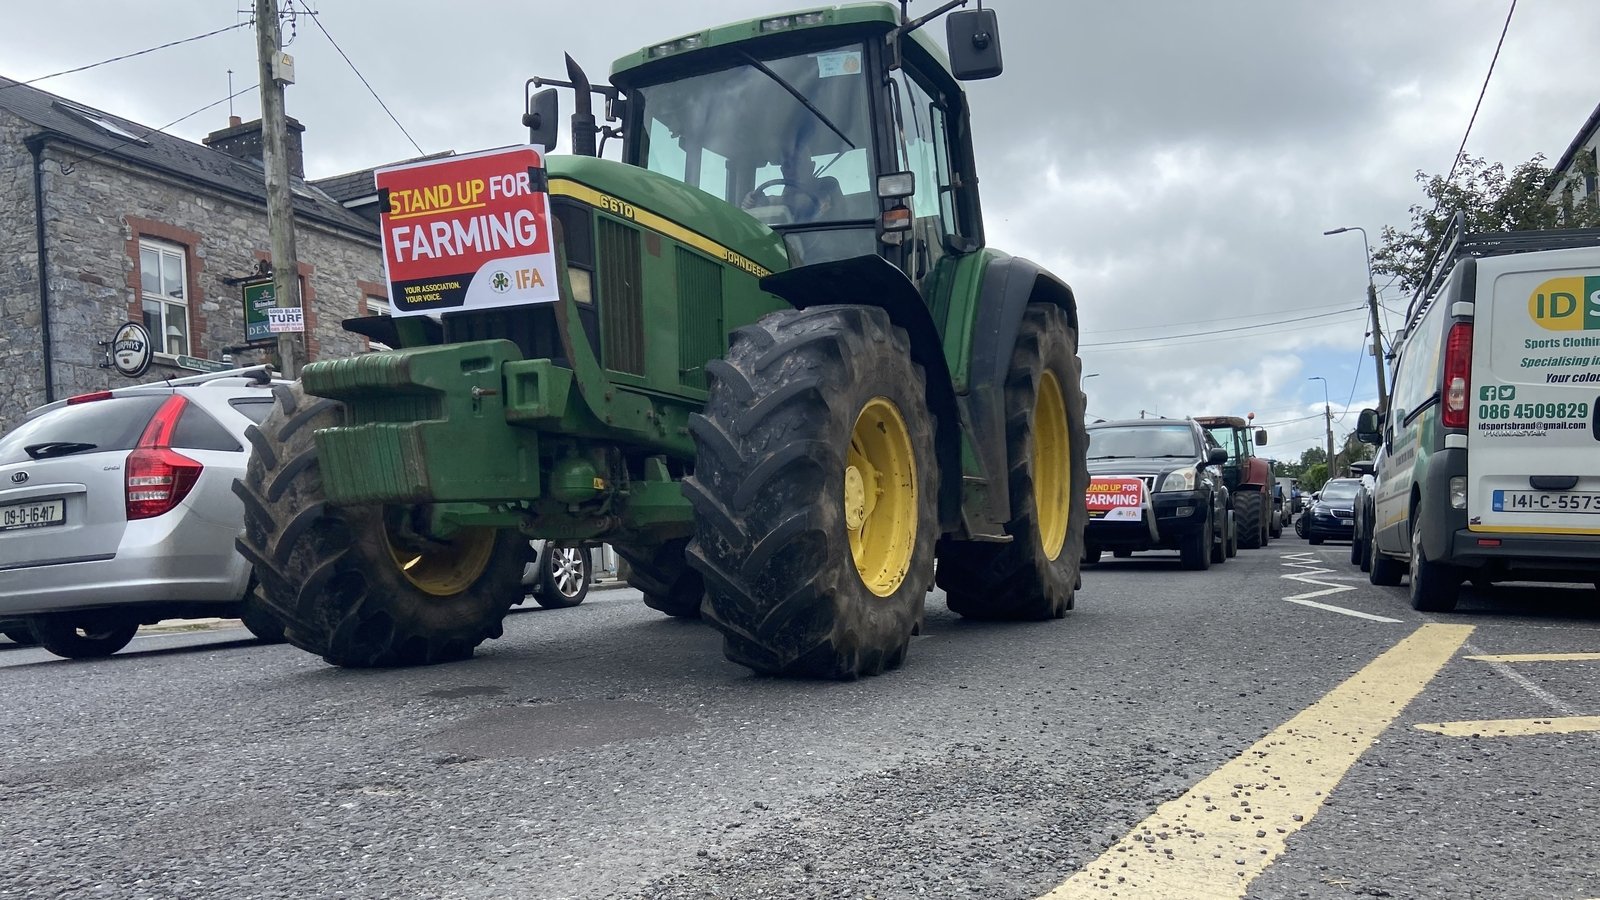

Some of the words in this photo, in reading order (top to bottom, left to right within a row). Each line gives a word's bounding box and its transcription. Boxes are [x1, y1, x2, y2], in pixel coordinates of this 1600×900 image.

[389, 184, 453, 215] STAND
[457, 179, 485, 204] UP
[489, 172, 531, 200] FOR
[600, 194, 635, 220] 6610
[392, 209, 537, 262] FARMING
[723, 250, 746, 269] JOHN
[515, 268, 544, 289] IFA
[404, 286, 421, 294] YOUR
[422, 281, 461, 293] ASSOCIATION.
[406, 295, 422, 303] YOUR
[423, 293, 442, 302] VOICE.
[1536, 292, 1577, 319] ID
[270, 314, 302, 323] TURF
[1524, 339, 1560, 349] Sports
[1520, 356, 1590, 368] Specialising
[1546, 373, 1570, 383] Your
[1479, 404, 1510, 419] 086
[1513, 403, 1588, 419] 4509829
[1478, 421, 1586, 431] idsportsbrand@gmail.com
[13, 472, 28, 482] KIA
[4, 506, 55, 525] 09-D-16417
